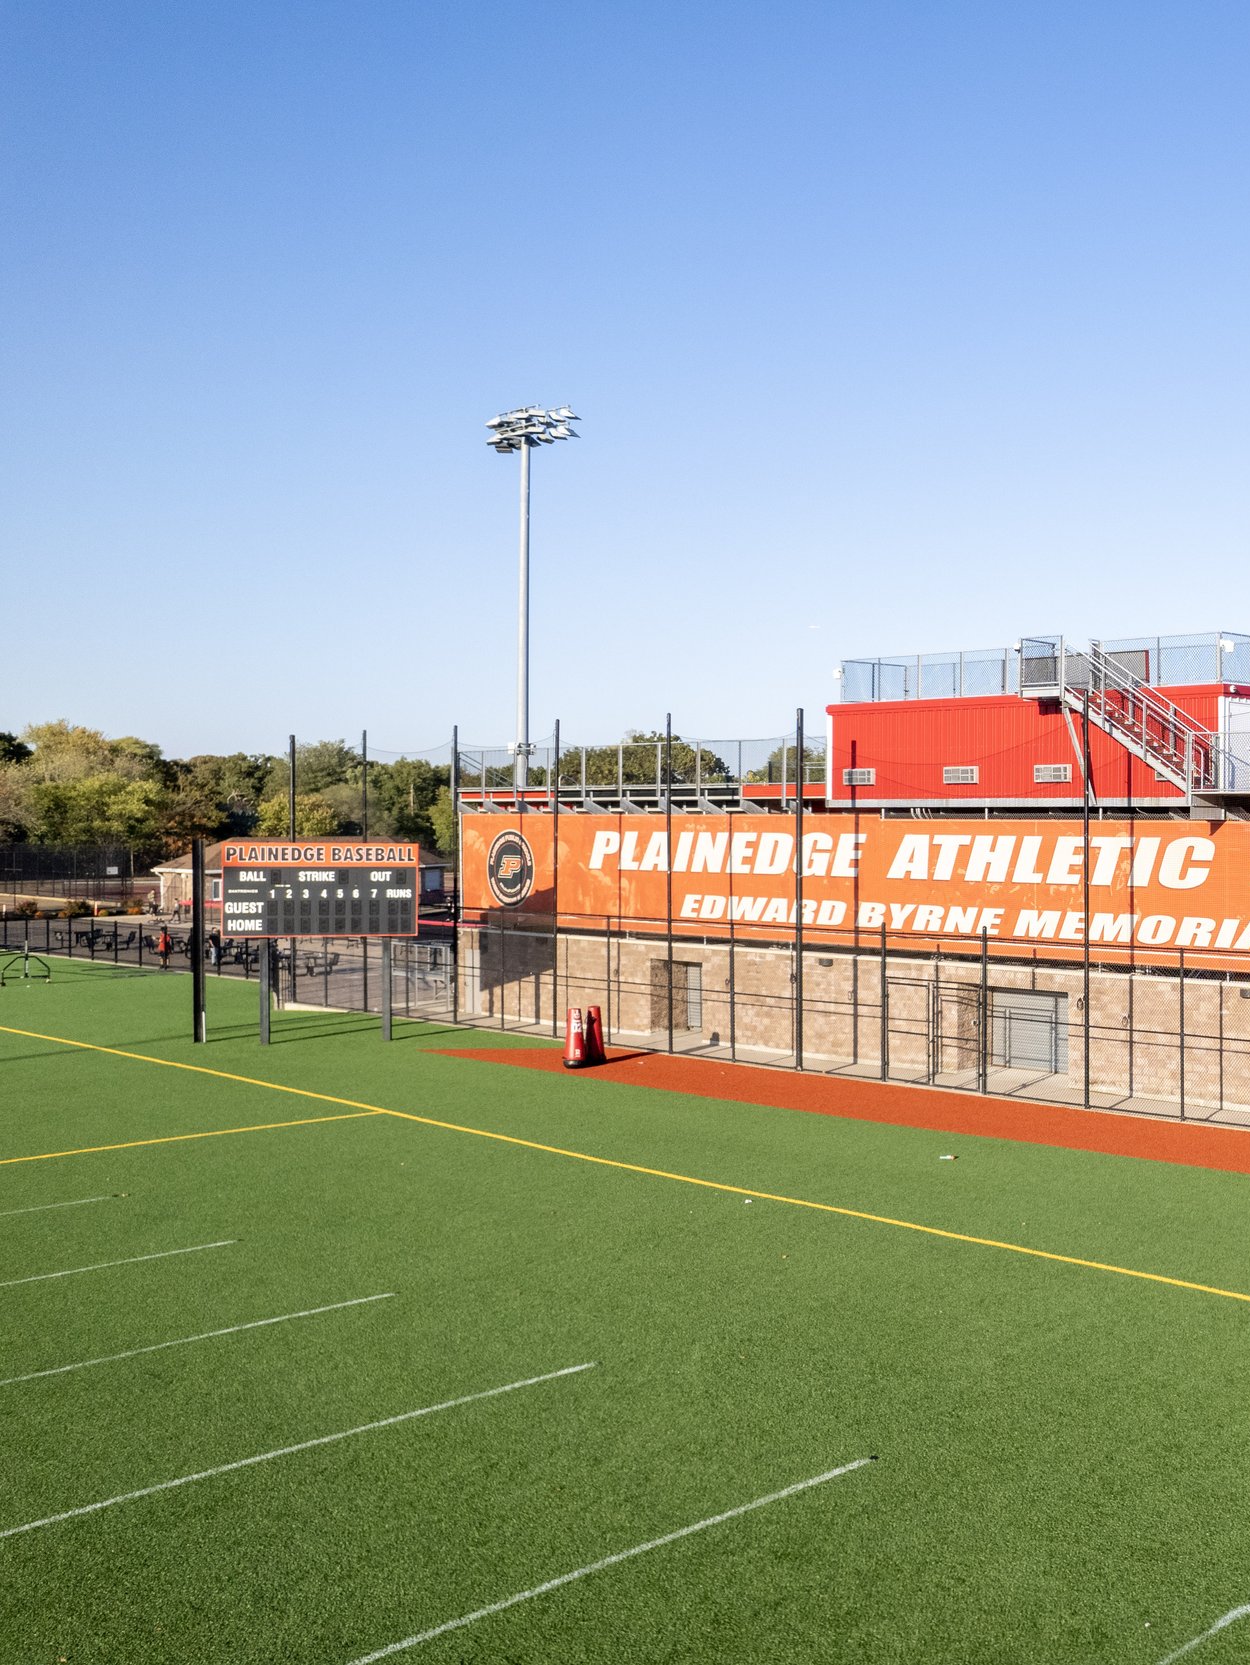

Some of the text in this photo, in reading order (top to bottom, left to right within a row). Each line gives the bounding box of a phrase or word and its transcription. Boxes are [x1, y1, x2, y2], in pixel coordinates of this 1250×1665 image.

[225, 846, 415, 862] PLAINEDGE BASEBALL
[588, 831, 867, 877] PLAINEDGE
[886, 833, 1216, 889] ATHLETIC
[498, 855, 523, 878] P
[239, 871, 391, 882] BALL STRIKE OUT
[270, 889, 412, 899] 1 2 3 4 5 6 7 RUNS
[225, 902, 264, 914] GUEST
[680, 894, 847, 926] EDWARD
[857, 902, 1005, 935] BYRNE
[227, 919, 263, 931] HOME
